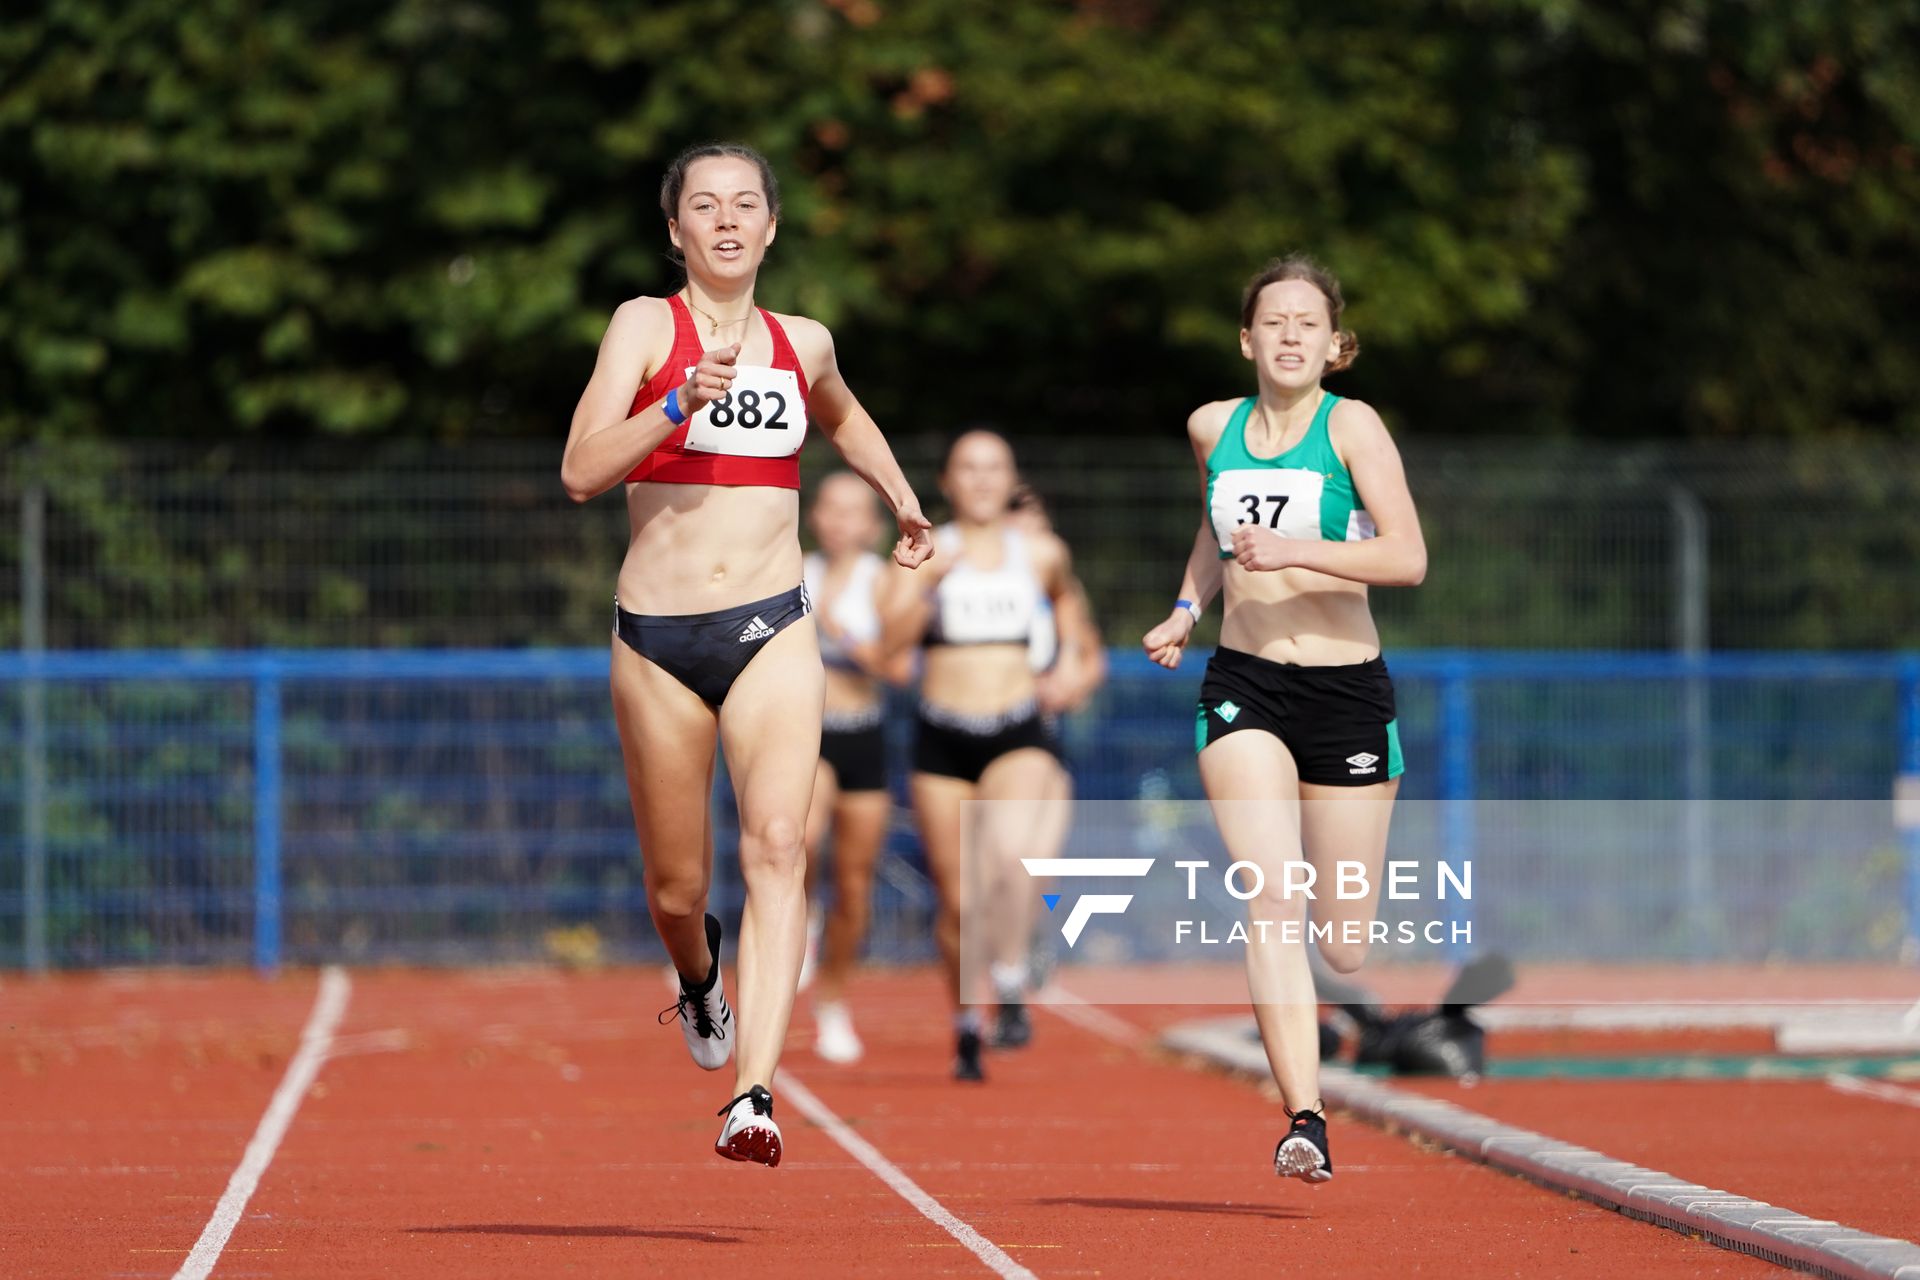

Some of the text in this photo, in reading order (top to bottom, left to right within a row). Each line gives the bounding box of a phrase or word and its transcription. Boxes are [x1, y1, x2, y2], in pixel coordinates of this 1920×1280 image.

[709, 389, 788, 430] 882
[1237, 494, 1290, 529] 37
[739, 627, 775, 643] adidas
[1349, 766, 1377, 775] umbro
